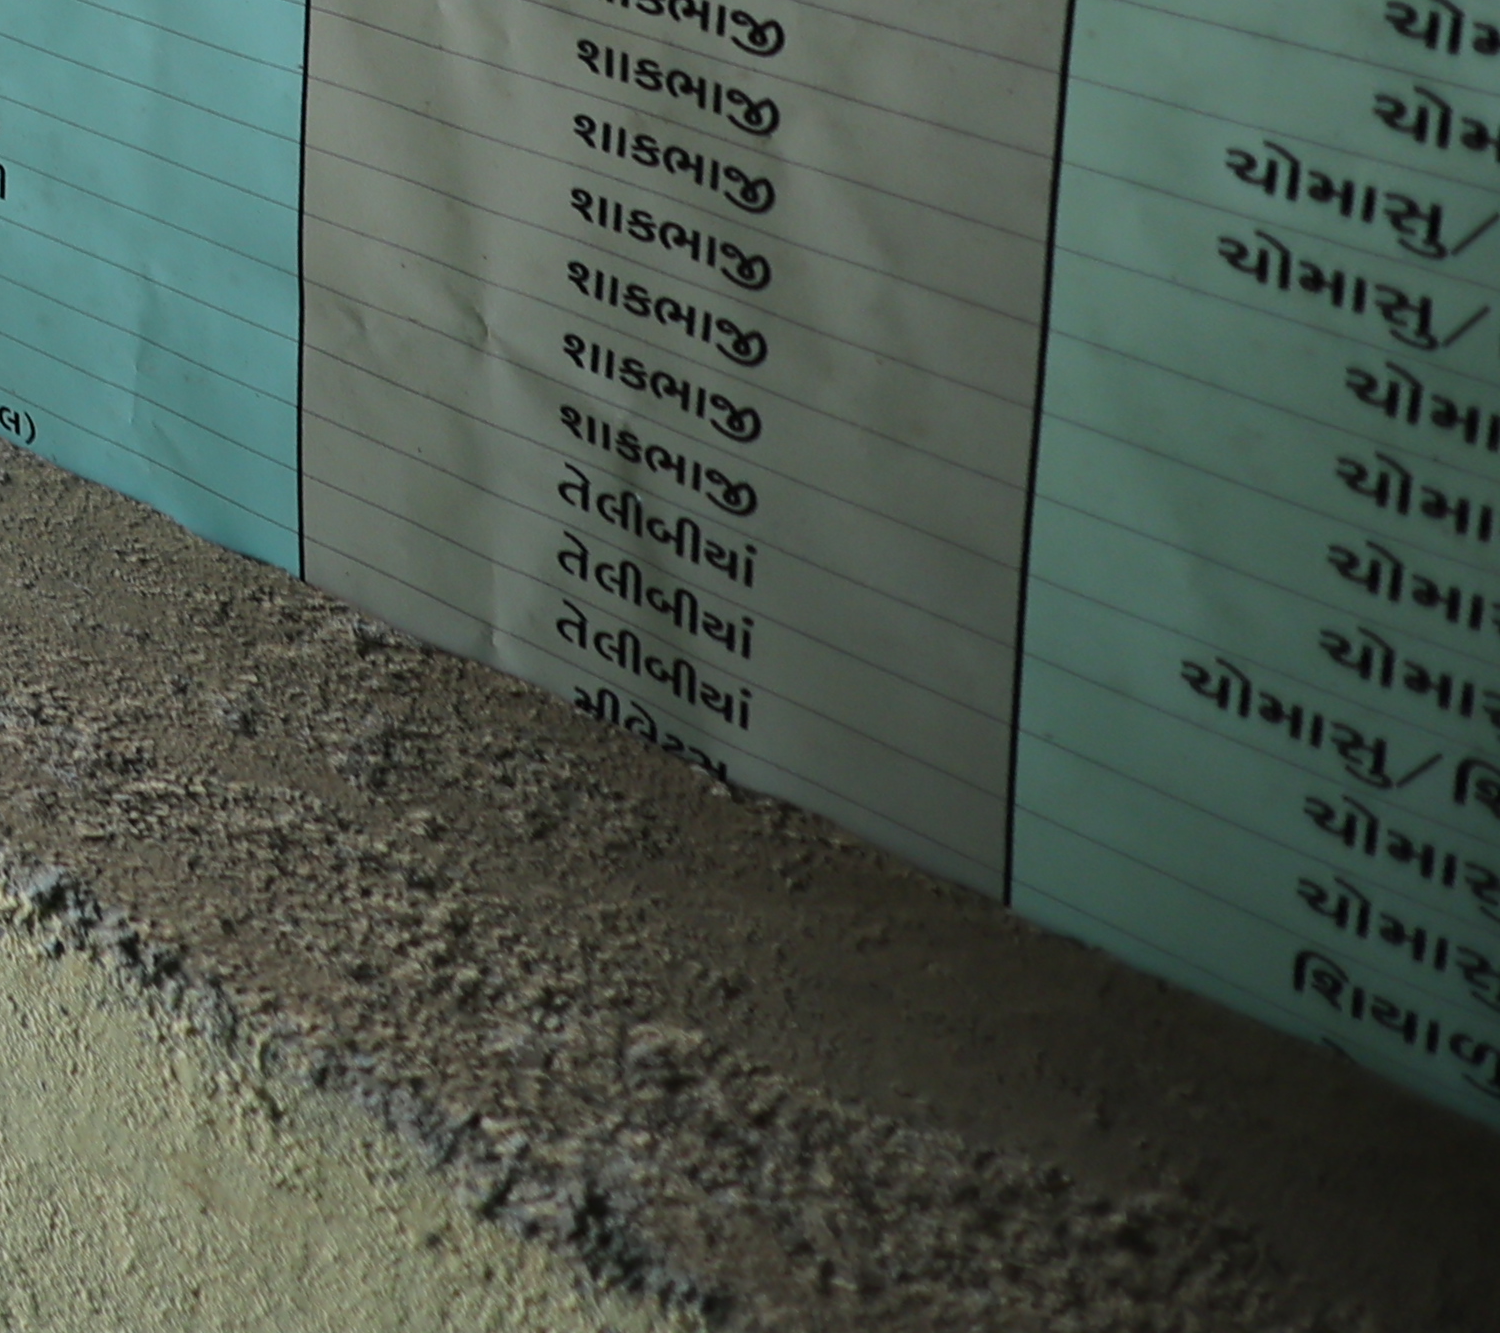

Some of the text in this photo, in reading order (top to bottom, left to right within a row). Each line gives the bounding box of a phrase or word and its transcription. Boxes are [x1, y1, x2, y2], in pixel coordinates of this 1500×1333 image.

[574, 114, 776, 214] શાકભાજી
[568, 261, 768, 368] શાકભાજી
[563, 333, 762, 443] શાકભાજી
[560, 404, 758, 517] શાકભાજી
[558, 463, 757, 587] તેલીબીયાં
[557, 531, 754, 659] તેલીબીયાં
[556, 599, 751, 730] તેલીબીયાં
